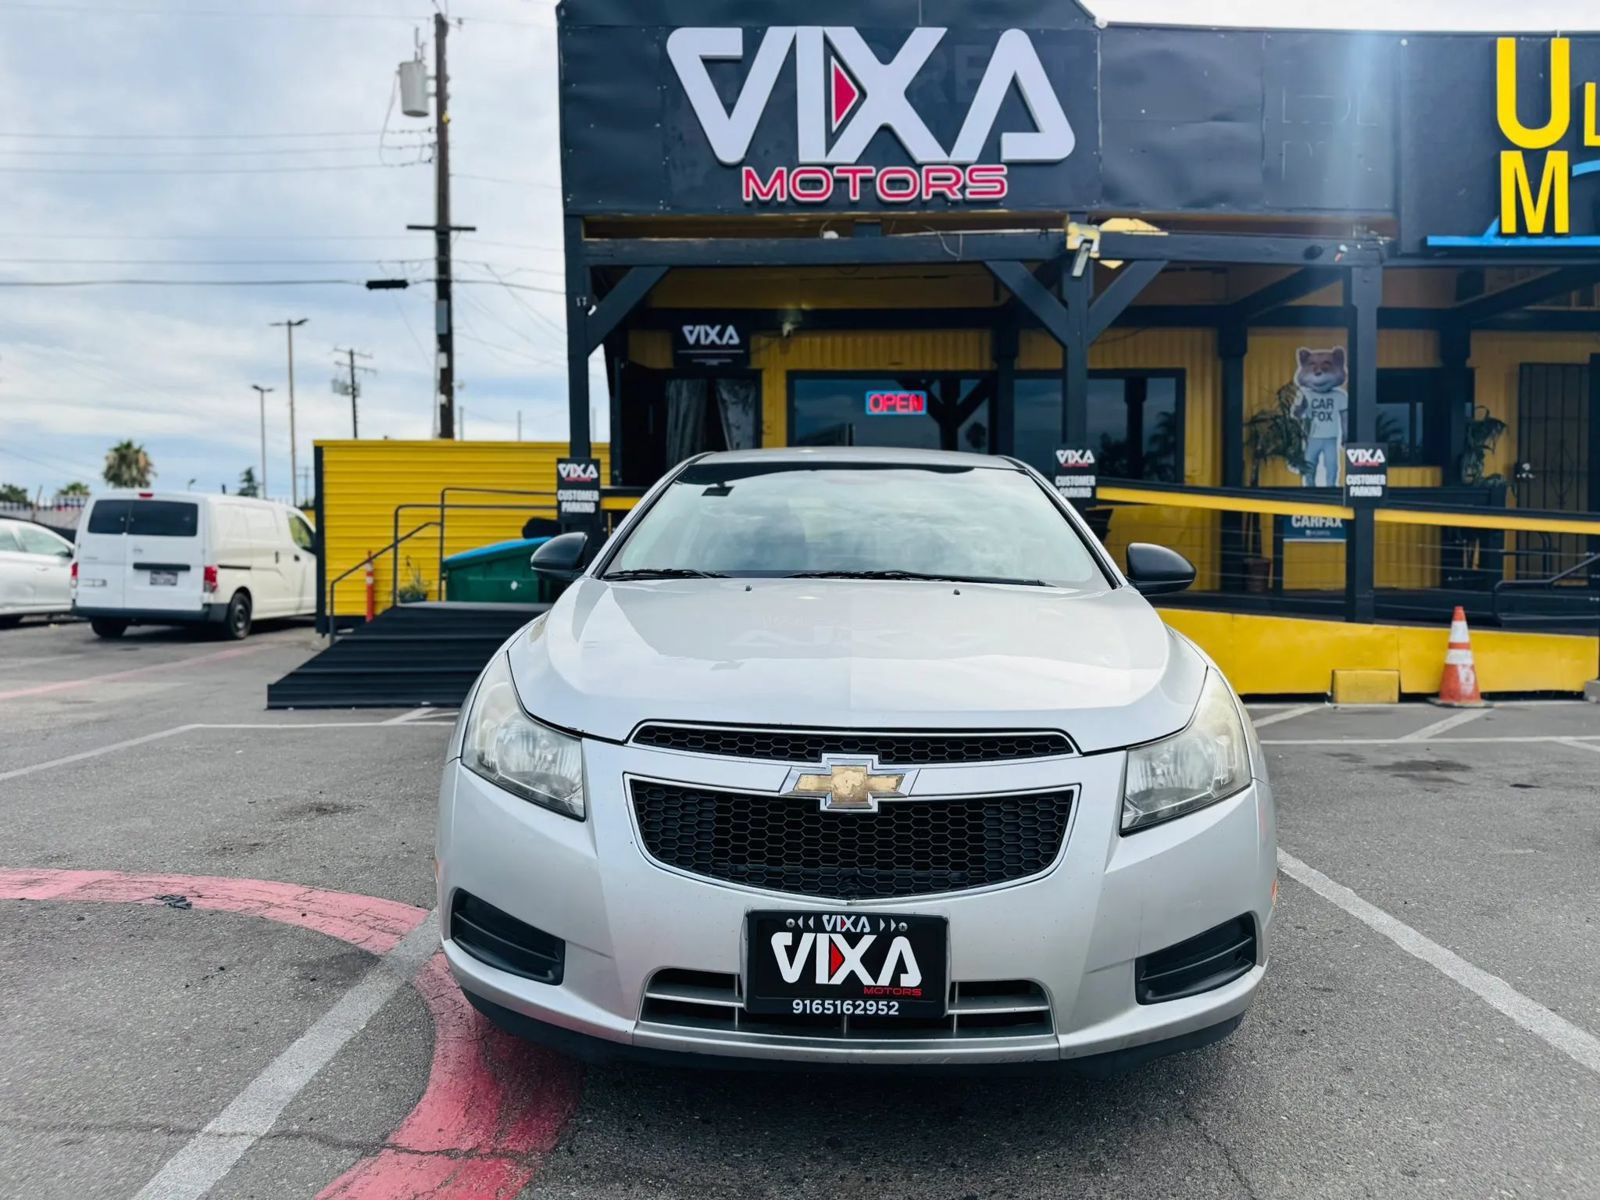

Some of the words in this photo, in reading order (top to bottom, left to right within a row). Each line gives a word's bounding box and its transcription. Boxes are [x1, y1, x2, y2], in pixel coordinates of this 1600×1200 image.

[666, 26, 1075, 165] VIXA
[742, 165, 1008, 202] MOTORS
[682, 324, 740, 345] VIXA
[869, 393, 924, 413] OPEN
[1311, 398, 1334, 410] CAR
[1311, 411, 1333, 422] FOX
[1056, 449, 1095, 464] VIXA
[1346, 448, 1386, 463] VIXA
[558, 463, 598, 478] VIXA
[1055, 475, 1096, 487] CUSTOMER
[1346, 474, 1386, 486] CUSTOMER
[557, 490, 599, 501] CUSTOMER
[1350, 485, 1382, 497] PARKING
[561, 502, 595, 513] PARKING
[822, 914, 871, 933] VIXA
[770, 931, 923, 988] VIXA
[863, 986, 923, 997] MOTORS
[792, 1000, 900, 1016] 9165162952
